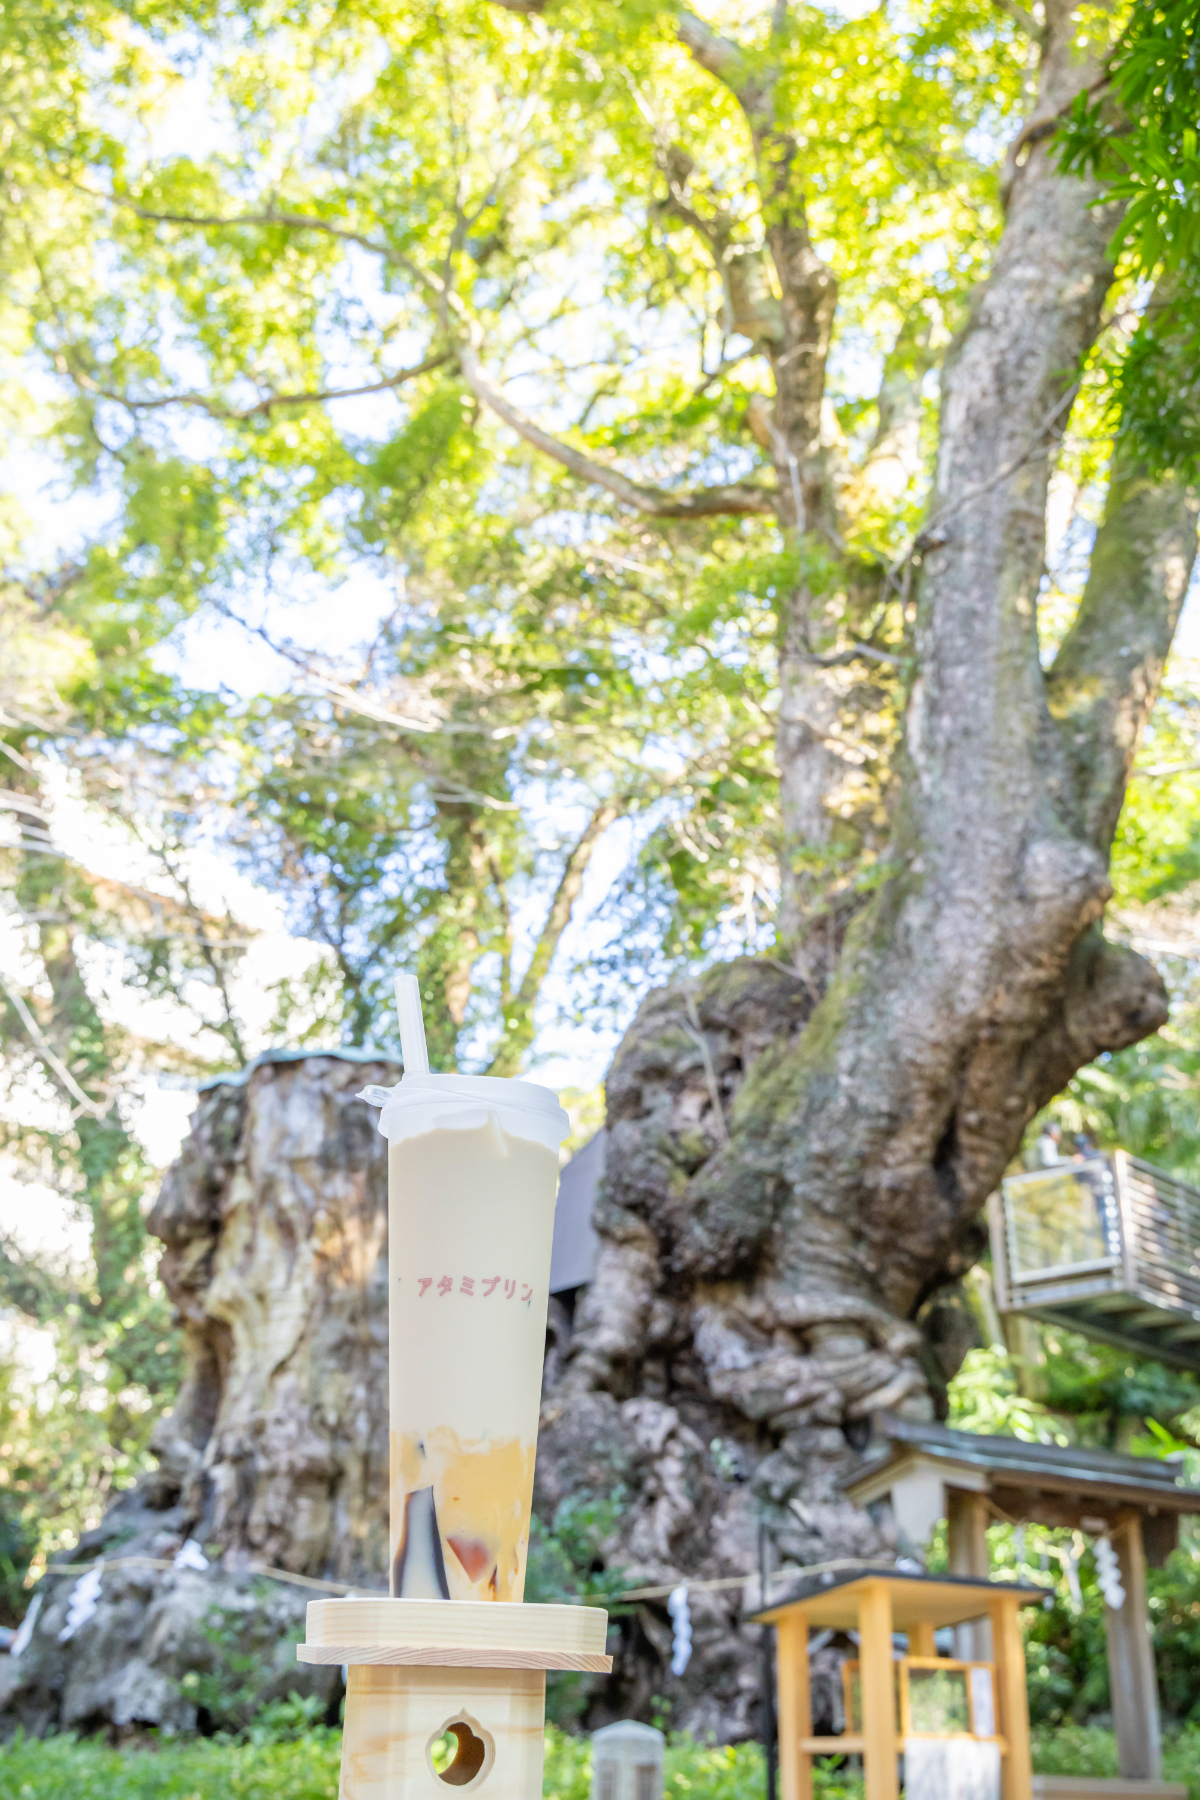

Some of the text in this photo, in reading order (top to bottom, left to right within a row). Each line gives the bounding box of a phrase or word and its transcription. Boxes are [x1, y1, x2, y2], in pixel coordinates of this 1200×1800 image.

[417, 1275, 533, 1301] アタミプリン
